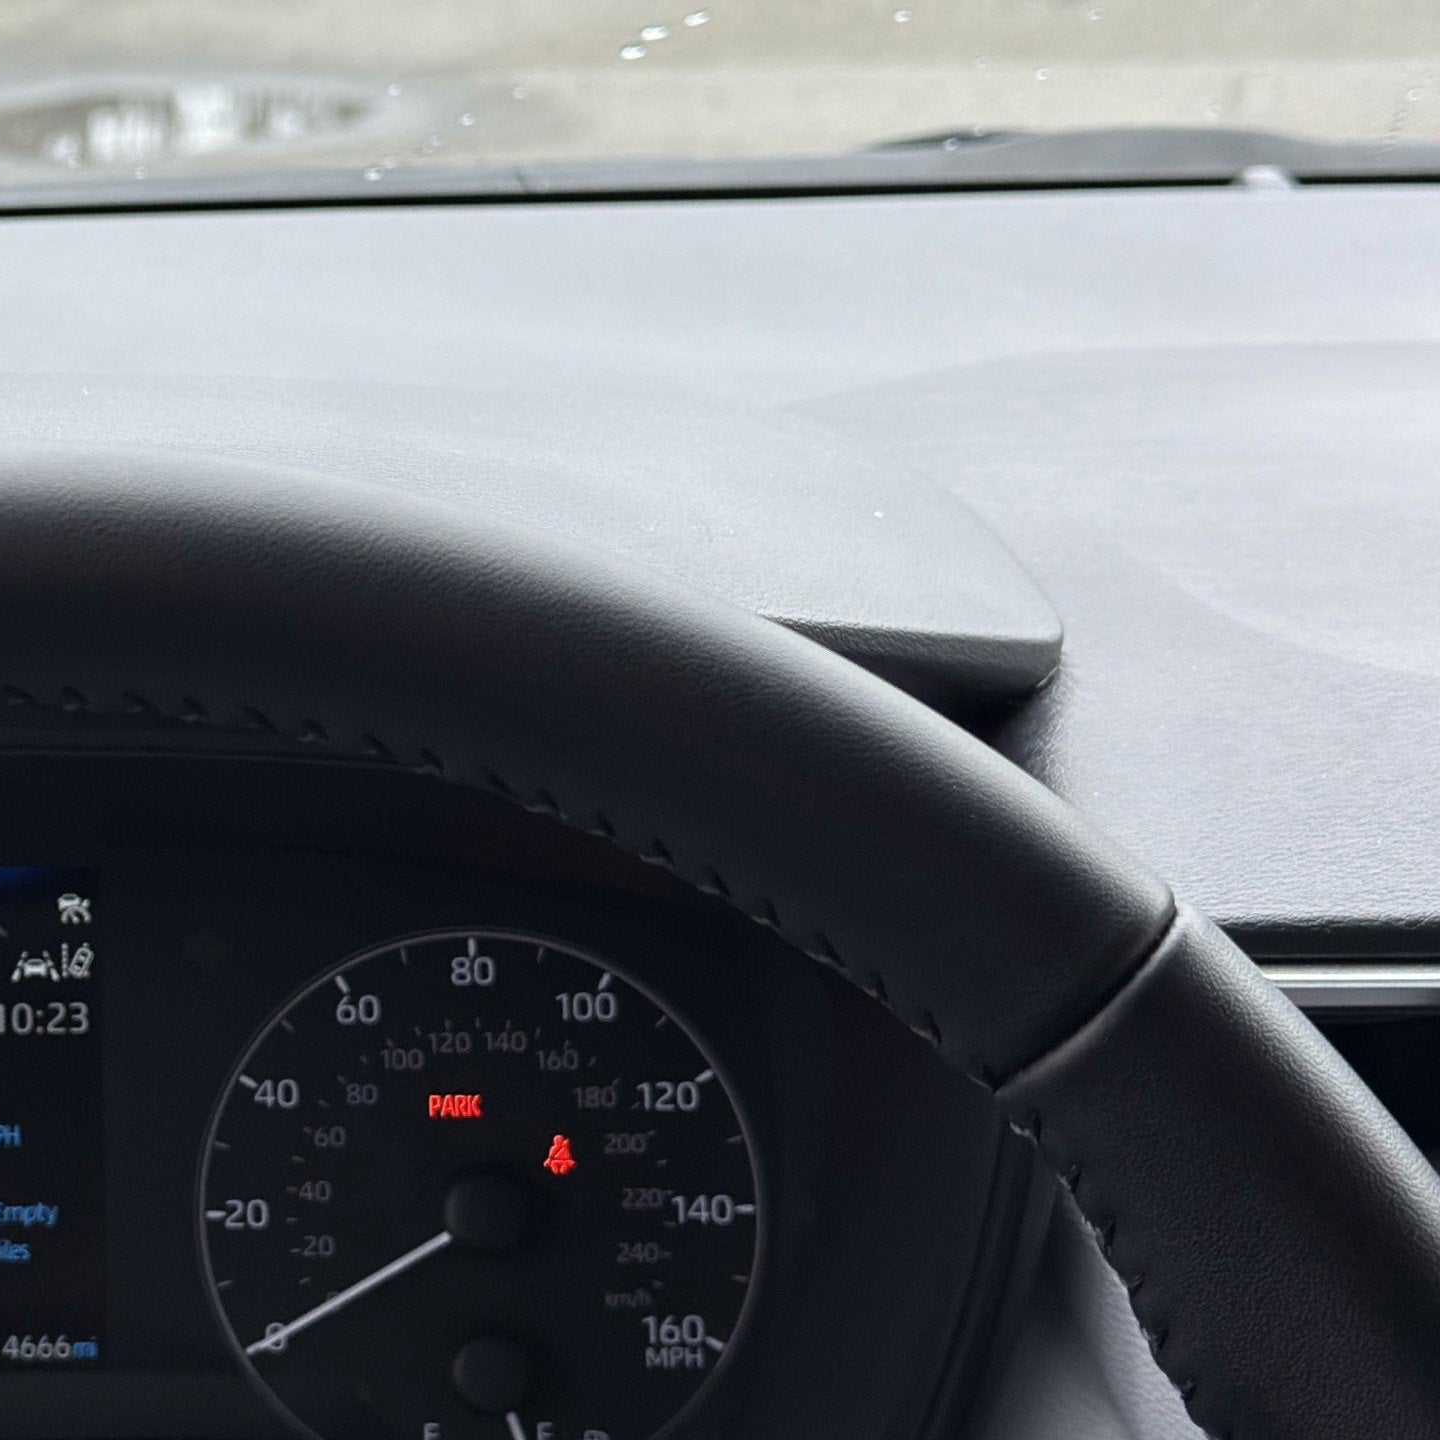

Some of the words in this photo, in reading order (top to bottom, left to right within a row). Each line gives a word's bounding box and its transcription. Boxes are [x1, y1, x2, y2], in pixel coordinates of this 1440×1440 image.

[450, 957, 496, 986] 80
[336, 995, 381, 1025] 60
[556, 992, 617, 1022] 100
[429, 1032, 471, 1053] 120
[484, 1031, 527, 1053] 140
[381, 1049, 424, 1070] 100
[535, 1049, 579, 1071] 160
[254, 1079, 300, 1108] 40
[346, 1083, 378, 1105] 80
[574, 1087, 617, 1109] 180
[637, 1081, 700, 1111] 120
[428, 1094, 482, 1118] PARK
[314, 1126, 346, 1148] 60
[604, 1133, 647, 1154] 200
[299, 1180, 332, 1202] 40
[622, 1188, 663, 1209] 220
[224, 1199, 270, 1229] 20
[671, 1194, 735, 1226] 140
[302, 1235, 336, 1257] 20
[642, 1314, 706, 1346] 160
[645, 1347, 705, 1368] MPH
